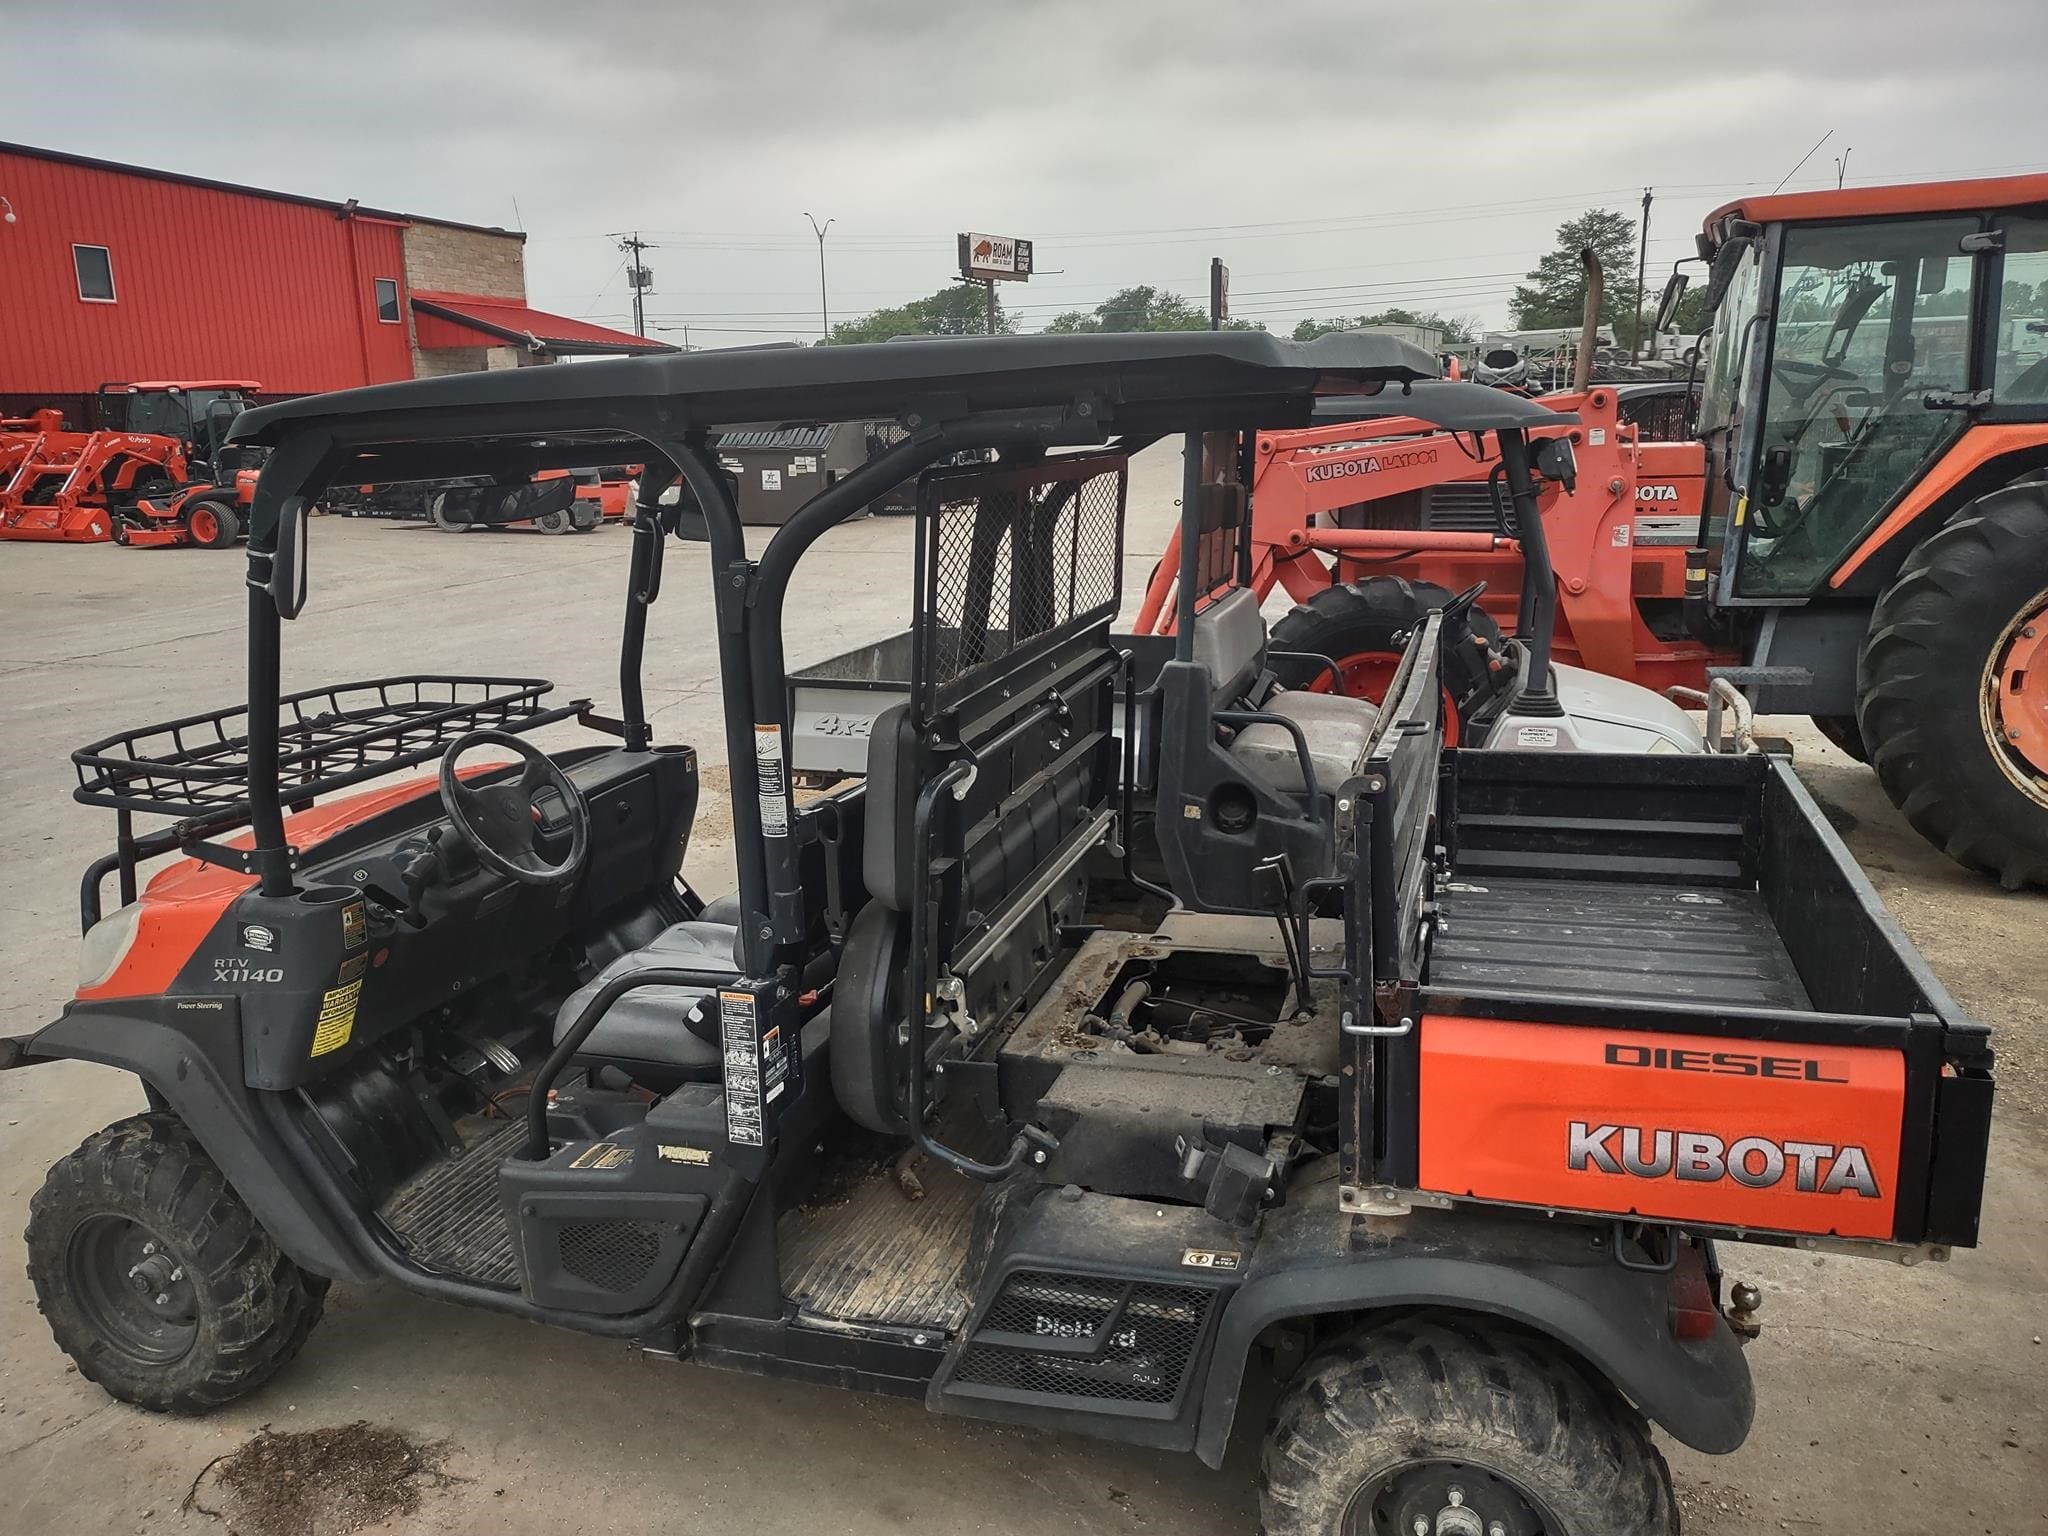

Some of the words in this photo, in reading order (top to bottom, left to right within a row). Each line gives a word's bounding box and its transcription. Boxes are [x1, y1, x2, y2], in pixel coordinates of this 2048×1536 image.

[992, 243, 1013, 259] ROAM
[128, 436, 151, 444] Kubota
[1306, 457, 1381, 483] KUBOTA
[1382, 449, 1438, 471] LA1001
[214, 958, 249, 968] RTV
[213, 968, 284, 983] X1140
[326, 981, 361, 1000] IMPORTANT
[196, 1002, 223, 1011] Steering
[1604, 1043, 1849, 1084] DIESEL
[1567, 1121, 1881, 1198] KUBOTA
[1036, 1315, 1137, 1348] DieHrd
